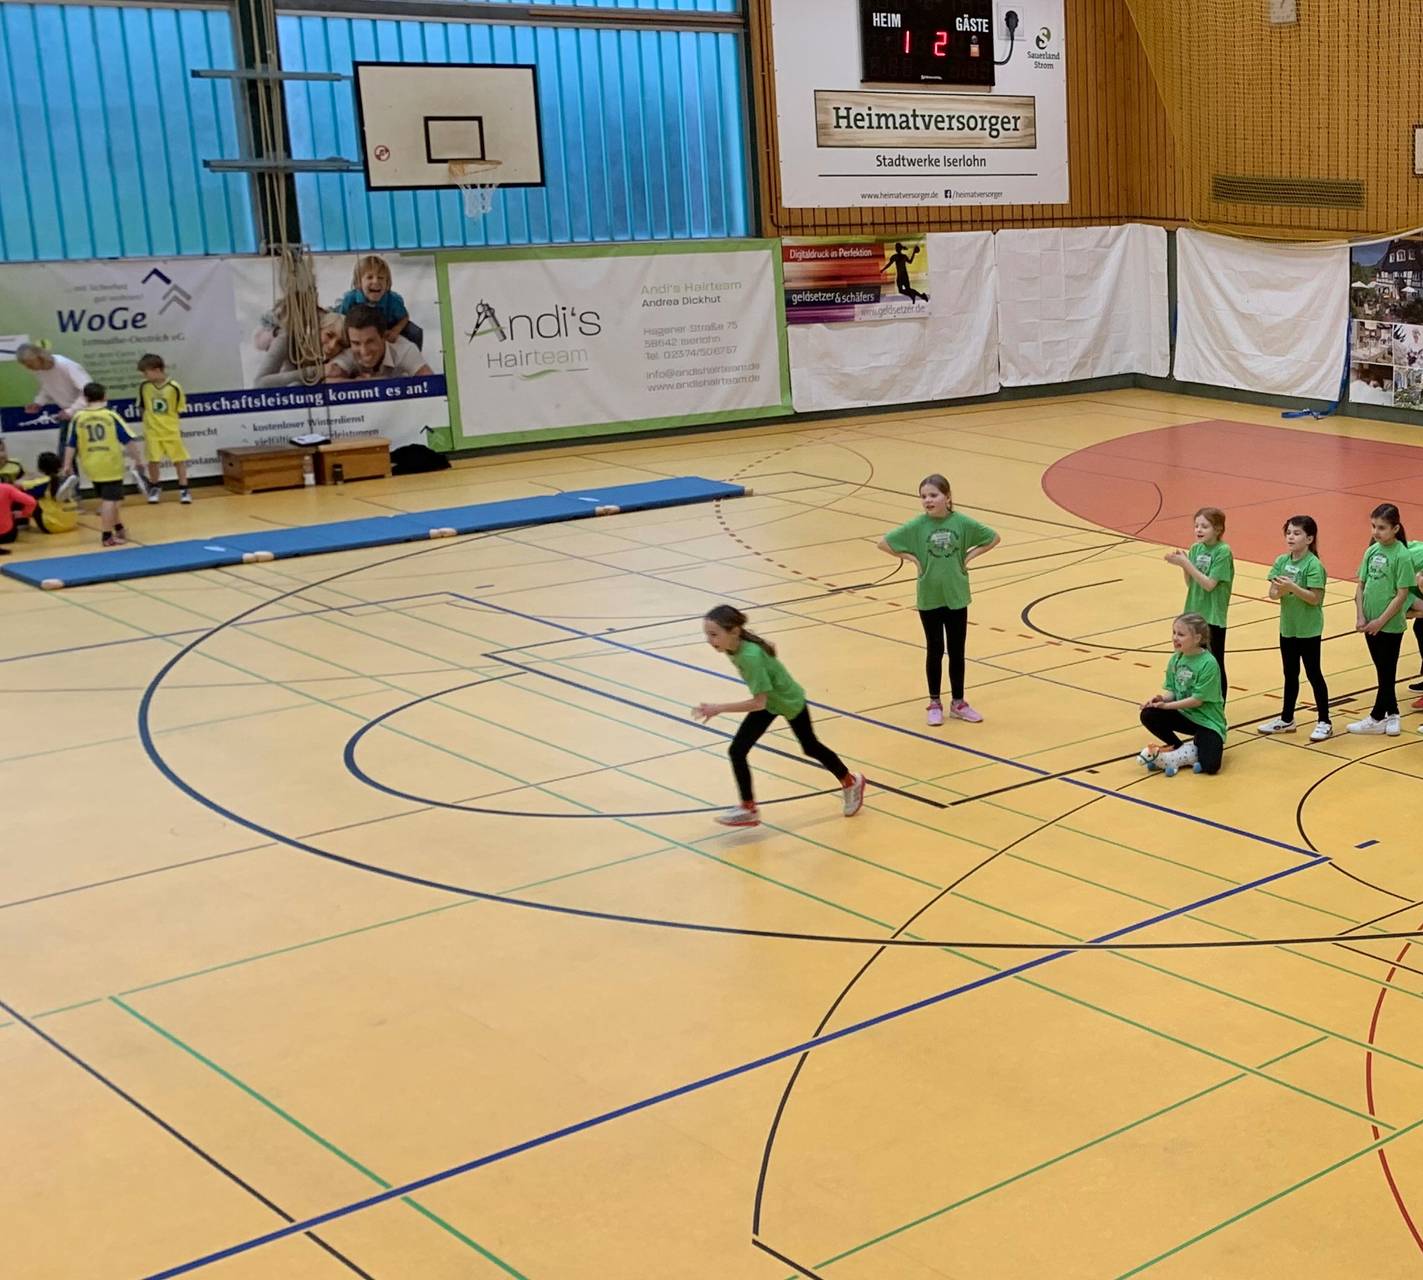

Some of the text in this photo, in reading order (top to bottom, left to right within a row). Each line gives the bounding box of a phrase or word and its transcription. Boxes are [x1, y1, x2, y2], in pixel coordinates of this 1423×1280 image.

[873, 12, 989, 33] HEIM GÄSTE
[904, 30, 948, 56] 1 2
[1027, 51, 1060, 61] Sauerland
[1034, 61, 1054, 70] Strom
[833, 106, 1021, 139] Heimatversorger
[876, 154, 986, 167] Stadtwerke Iserlohn
[860, 191, 939, 200] www.heimatversorger.de
[790, 247, 872, 261] Digitaldruck in Perfektion
[641, 281, 742, 295] Andi's Hairteam
[641, 295, 721, 308] Andrea Dickhut
[792, 291, 835, 305] geldsetzer
[842, 291, 874, 303] schäfers
[57, 307, 148, 333] WoGe
[468, 299, 602, 343] Andi's
[487, 348, 588, 369] Hairteam
[328, 386, 380, 401] kommt
[386, 387, 401, 397] es
[406, 381, 428, 395] an!
[86, 423, 105, 442] 10
